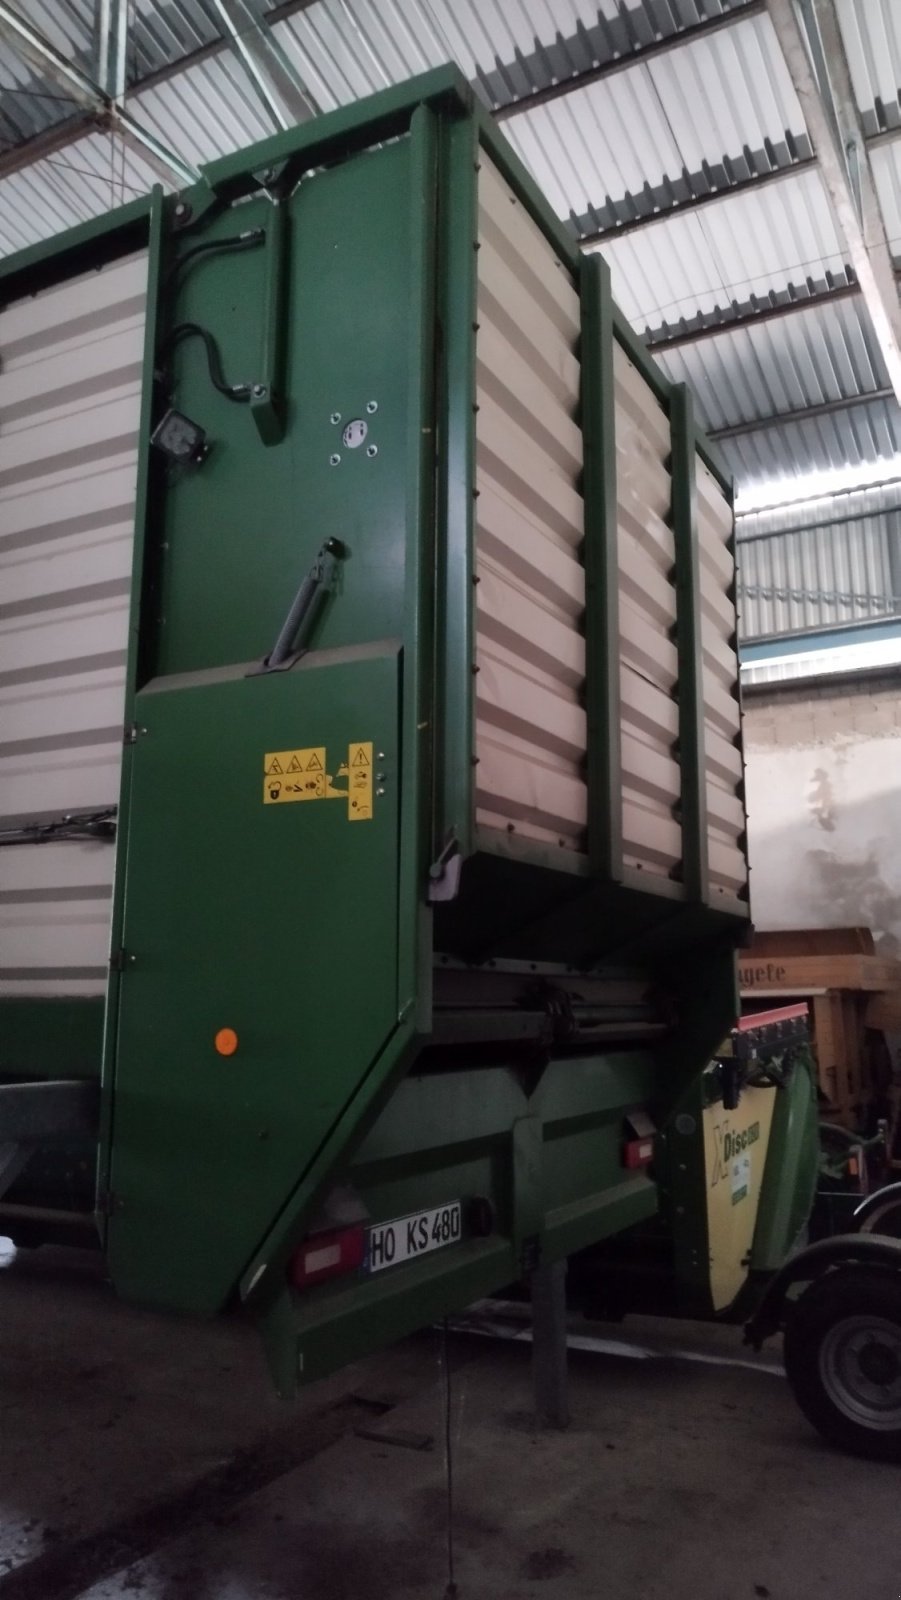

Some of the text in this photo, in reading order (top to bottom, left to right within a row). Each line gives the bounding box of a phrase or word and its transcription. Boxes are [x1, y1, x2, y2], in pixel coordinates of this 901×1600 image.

[372, 1207, 459, 1266] HO KS 480
